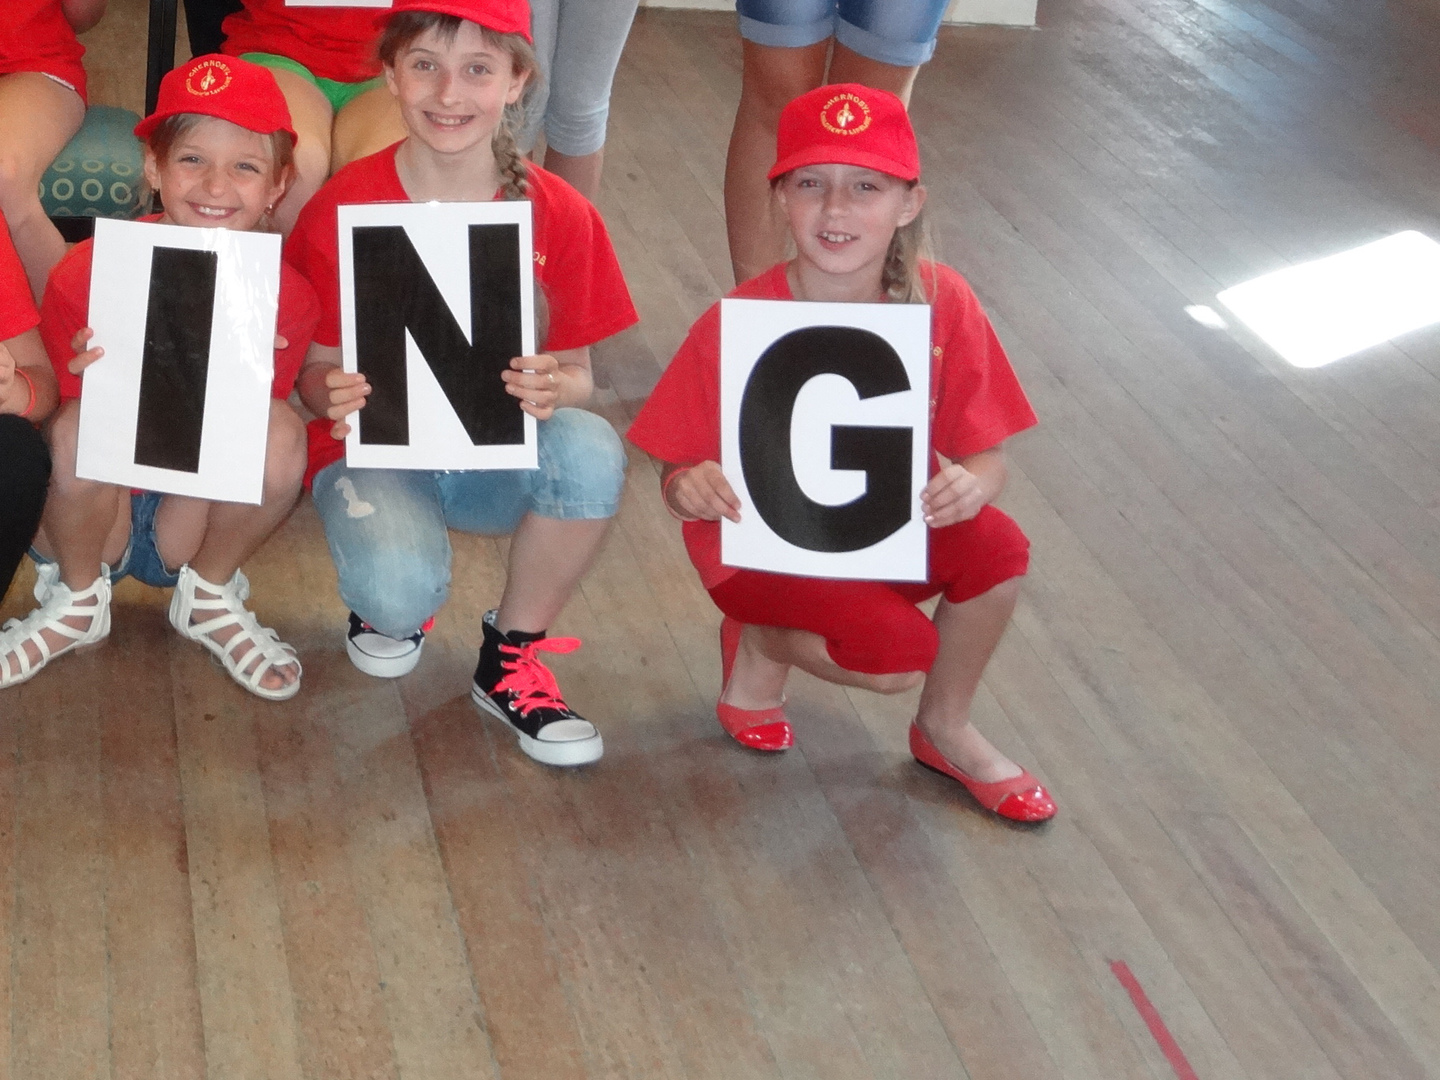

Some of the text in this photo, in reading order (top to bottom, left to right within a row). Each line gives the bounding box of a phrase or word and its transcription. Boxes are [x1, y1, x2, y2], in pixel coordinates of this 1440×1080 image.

[134, 246, 218, 474] I
[352, 223, 525, 447] N
[738, 326, 914, 553] G
